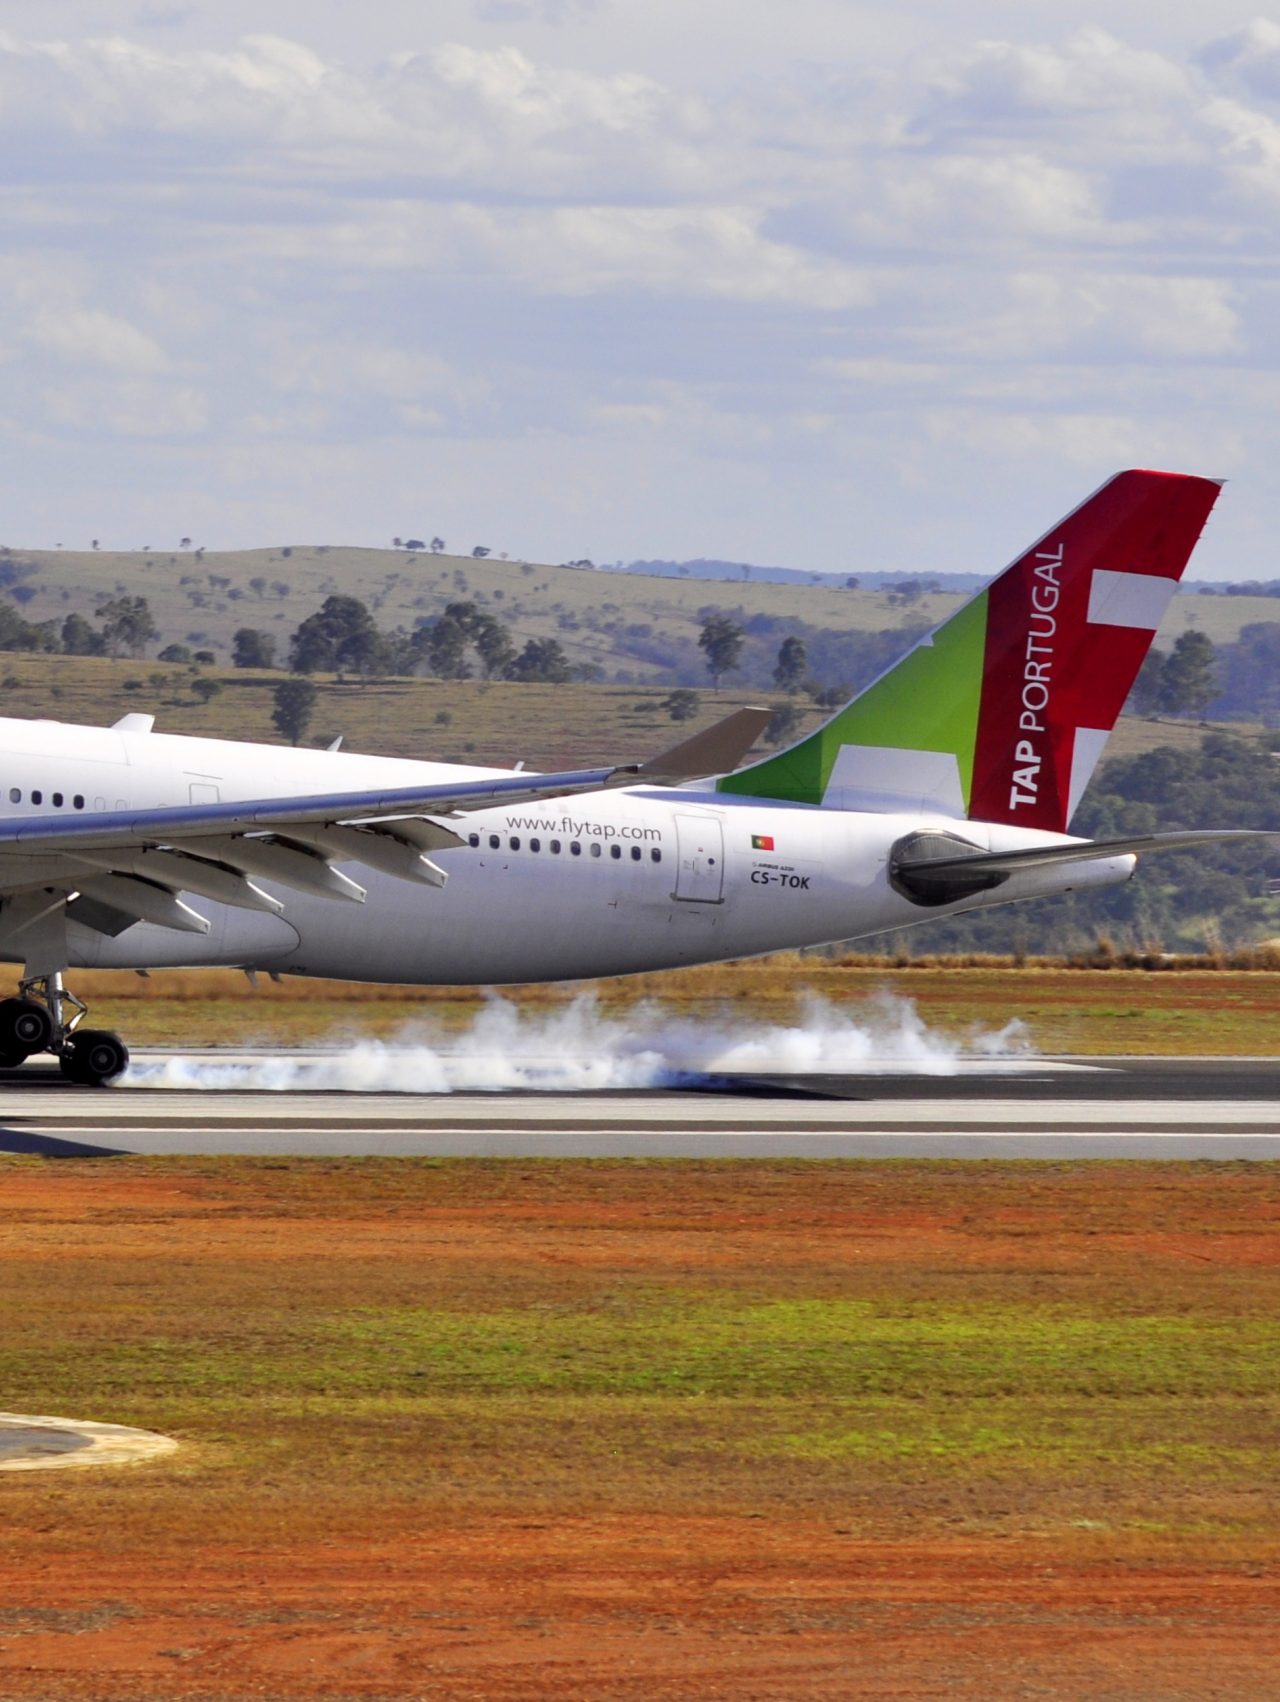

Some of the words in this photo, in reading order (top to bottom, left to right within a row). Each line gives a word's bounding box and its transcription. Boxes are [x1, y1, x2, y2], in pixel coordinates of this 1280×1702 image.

[1019, 543, 1064, 731] PORTUGAL
[1009, 739, 1042, 810] TAP
[506, 816, 662, 841] www.flytap.com
[750, 870, 811, 890] CS-TOK
